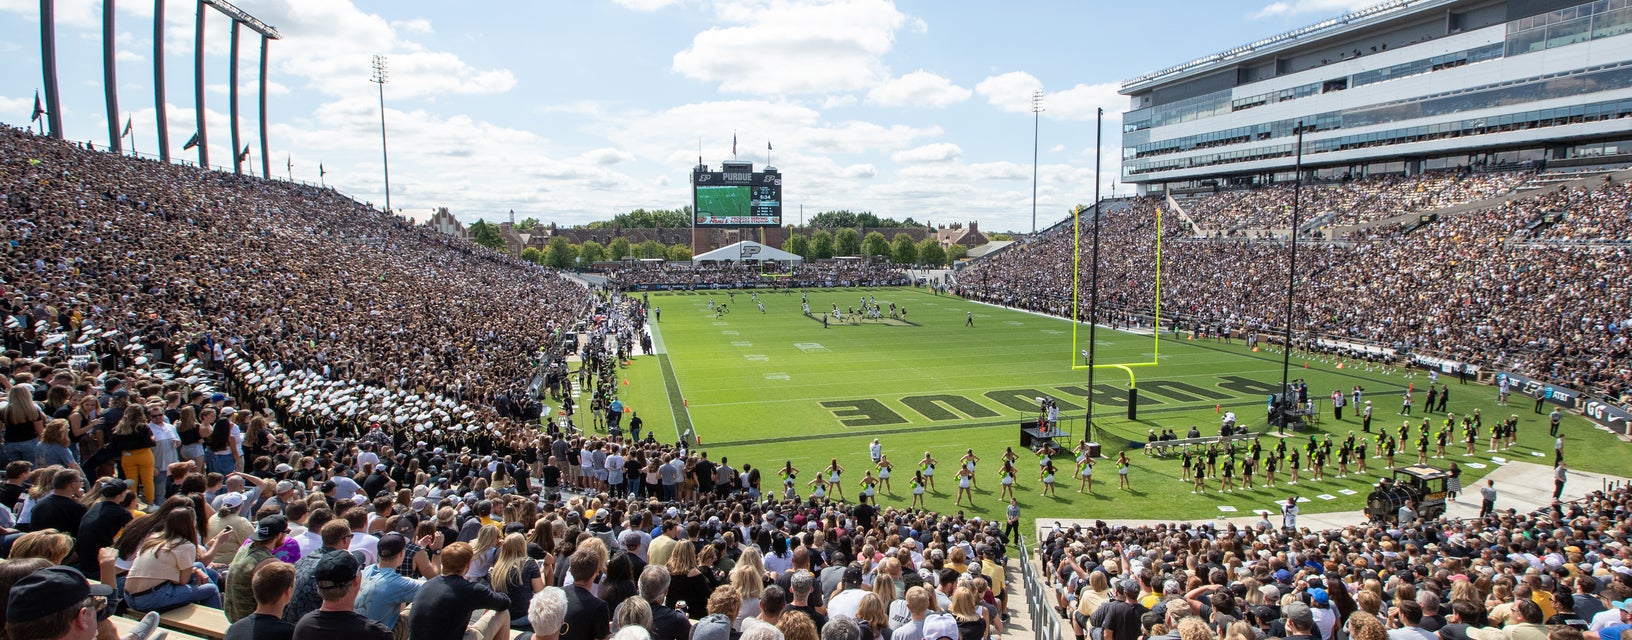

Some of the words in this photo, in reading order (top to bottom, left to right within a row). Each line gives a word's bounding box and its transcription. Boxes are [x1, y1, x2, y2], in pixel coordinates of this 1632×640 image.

[722, 172, 752, 181] PURDUE
[740, 246, 761, 257] P
[1419, 358, 1440, 368] TOYOTA
[1453, 364, 1476, 375] TOOTA
[1552, 391, 1570, 402] AT&T
[1587, 401, 1607, 420] GG
